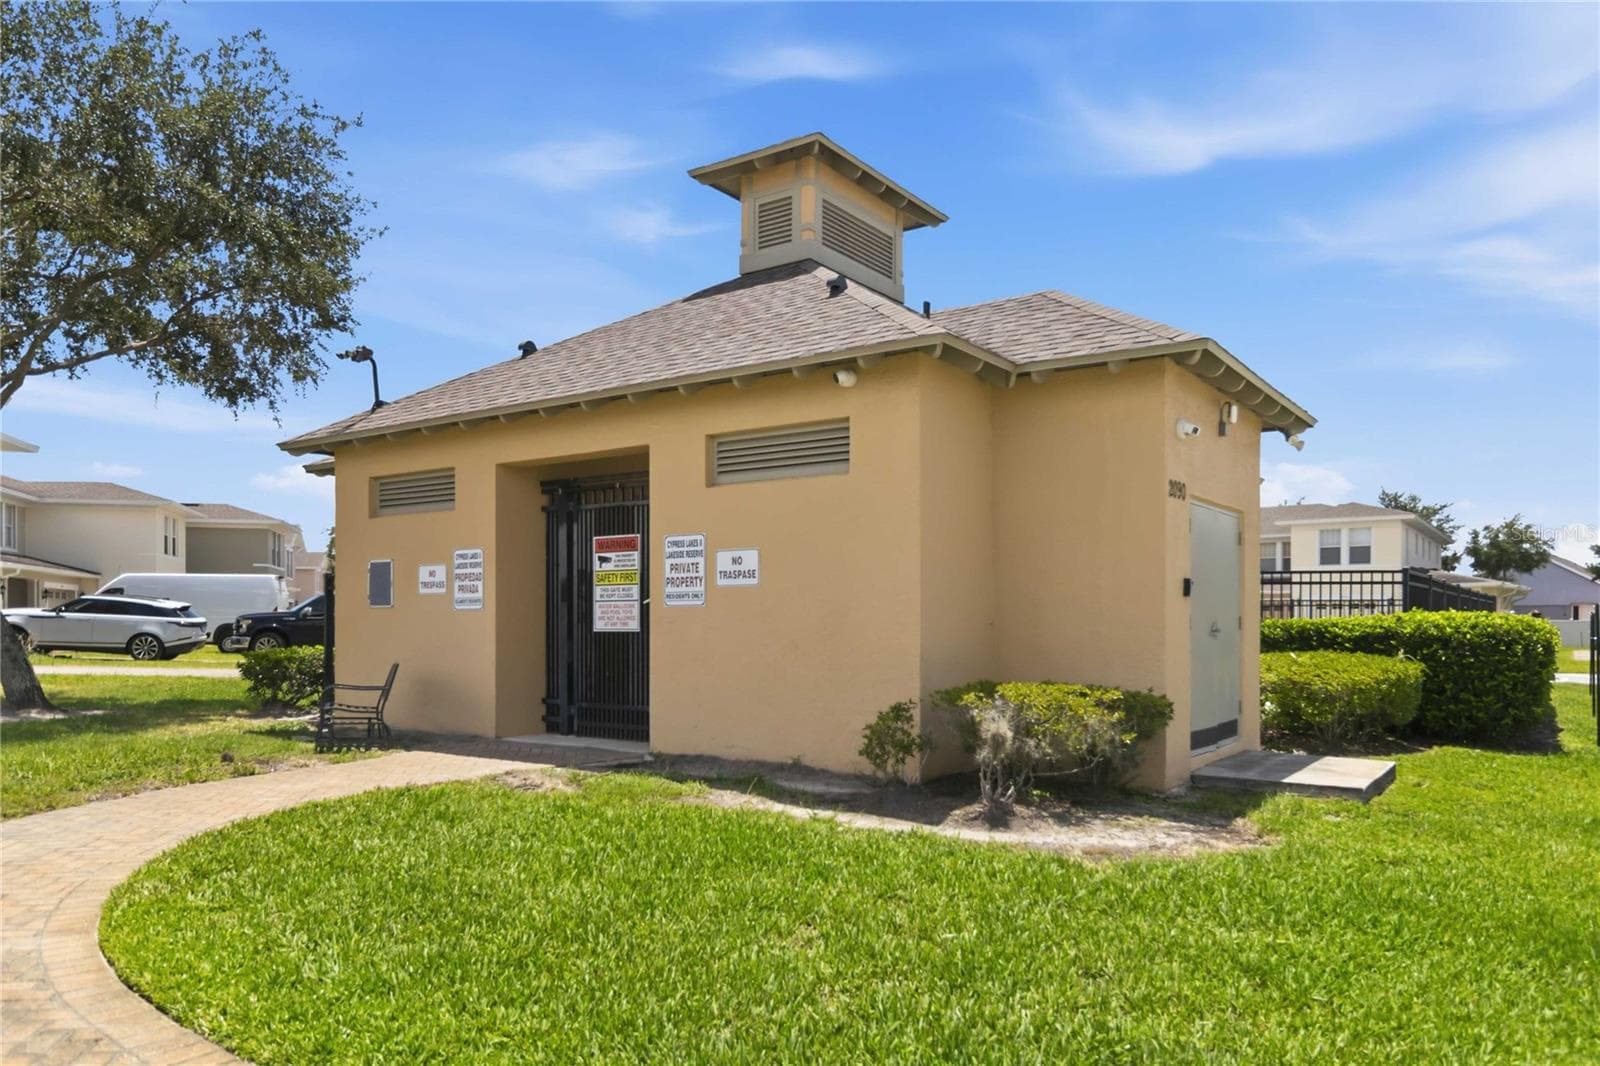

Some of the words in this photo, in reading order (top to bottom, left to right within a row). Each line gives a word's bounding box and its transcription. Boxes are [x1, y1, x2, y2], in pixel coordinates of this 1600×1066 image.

[597, 539, 636, 550] WARNING
[667, 539, 685, 548] CYPRESS
[686, 539, 698, 547] LAKES
[666, 550, 685, 559] LAKESIDE
[686, 549, 704, 558] RESERVE
[731, 556, 743, 566] NO
[669, 562, 700, 574] PRIVATE
[429, 570, 436, 578] NO
[455, 572, 482, 582] PROPIEDAD
[596, 572, 617, 583] SAFETY
[619, 572, 637, 583] FIRST
[719, 569, 756, 580] TRASPASE
[420, 581, 445, 589] TRESPASS
[666, 576, 703, 588] PROPERTY
[457, 584, 479, 593] PRIVADA
